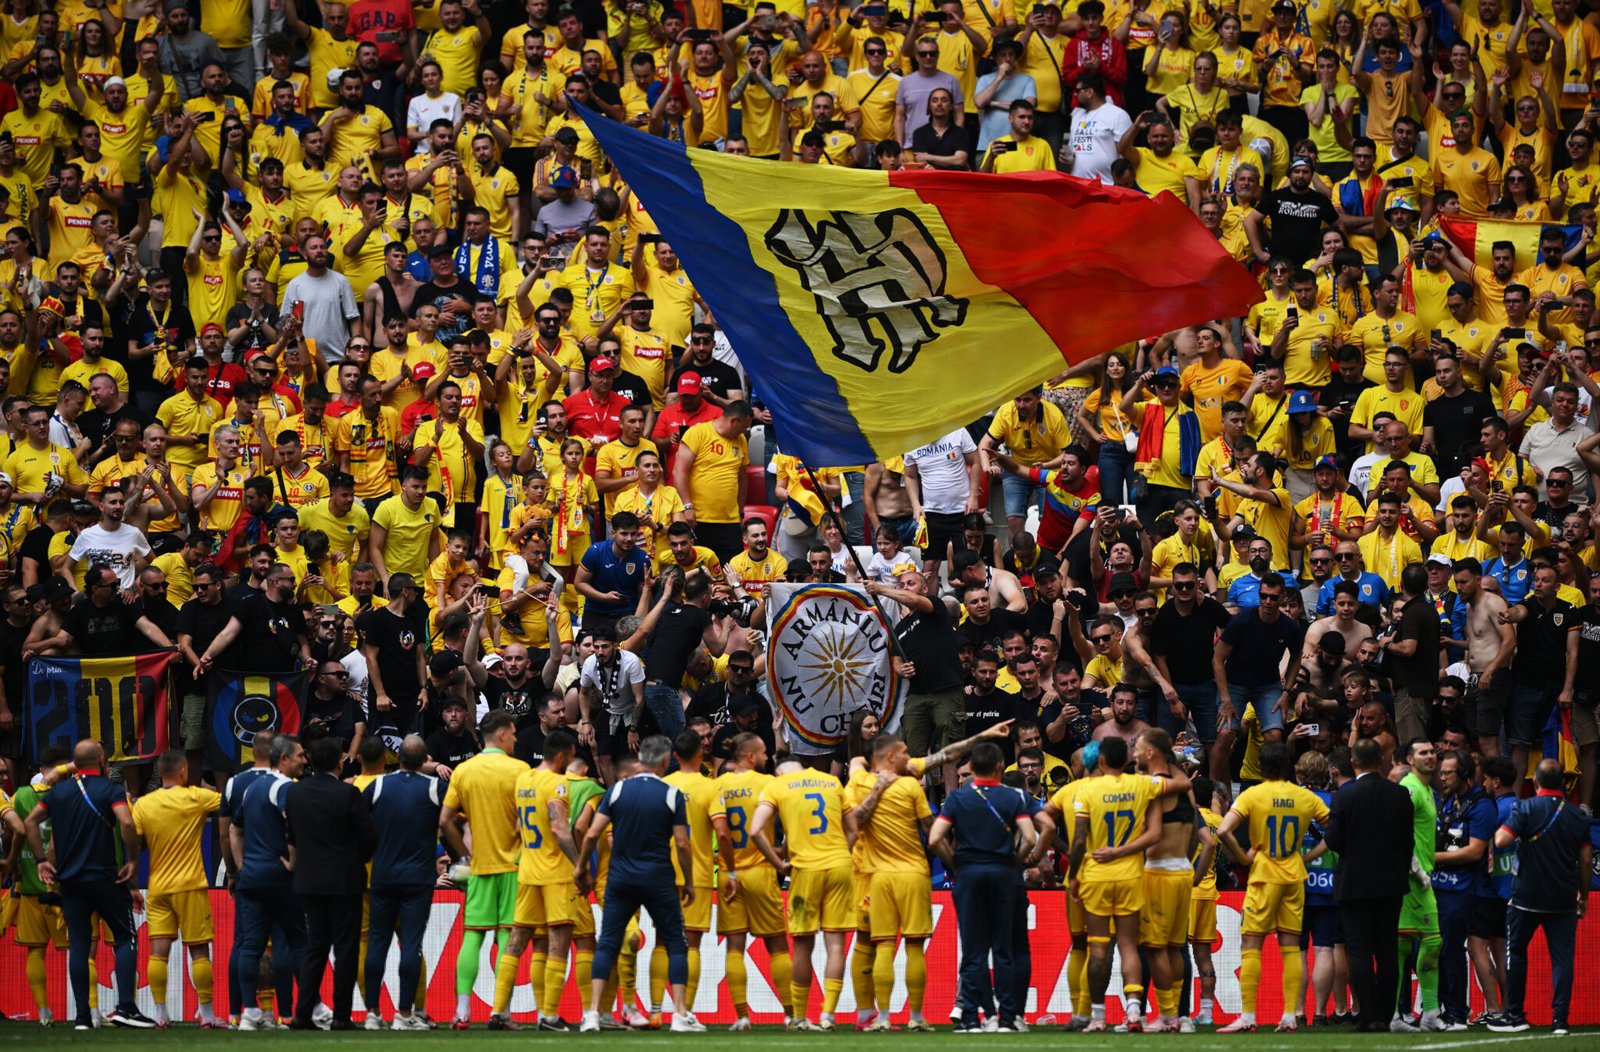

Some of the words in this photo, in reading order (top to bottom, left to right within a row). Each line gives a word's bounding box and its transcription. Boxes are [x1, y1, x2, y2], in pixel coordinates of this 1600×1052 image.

[360, 11, 396, 30] GAP
[710, 442, 724, 455] 10
[917, 443, 953, 457] ROMANIA
[289, 487, 299, 498] 10
[782, 597, 888, 662] ARMÂNLU
[781, 675, 815, 715] NU
[820, 671, 886, 734] CHARI
[804, 793, 829, 834] 3
[1103, 793, 1135, 804] COMAN
[1272, 798, 1295, 808] HAGI
[518, 806, 542, 849] 15
[727, 805, 748, 849] 9
[1103, 809, 1136, 847] 17
[1266, 815, 1299, 858] 10
